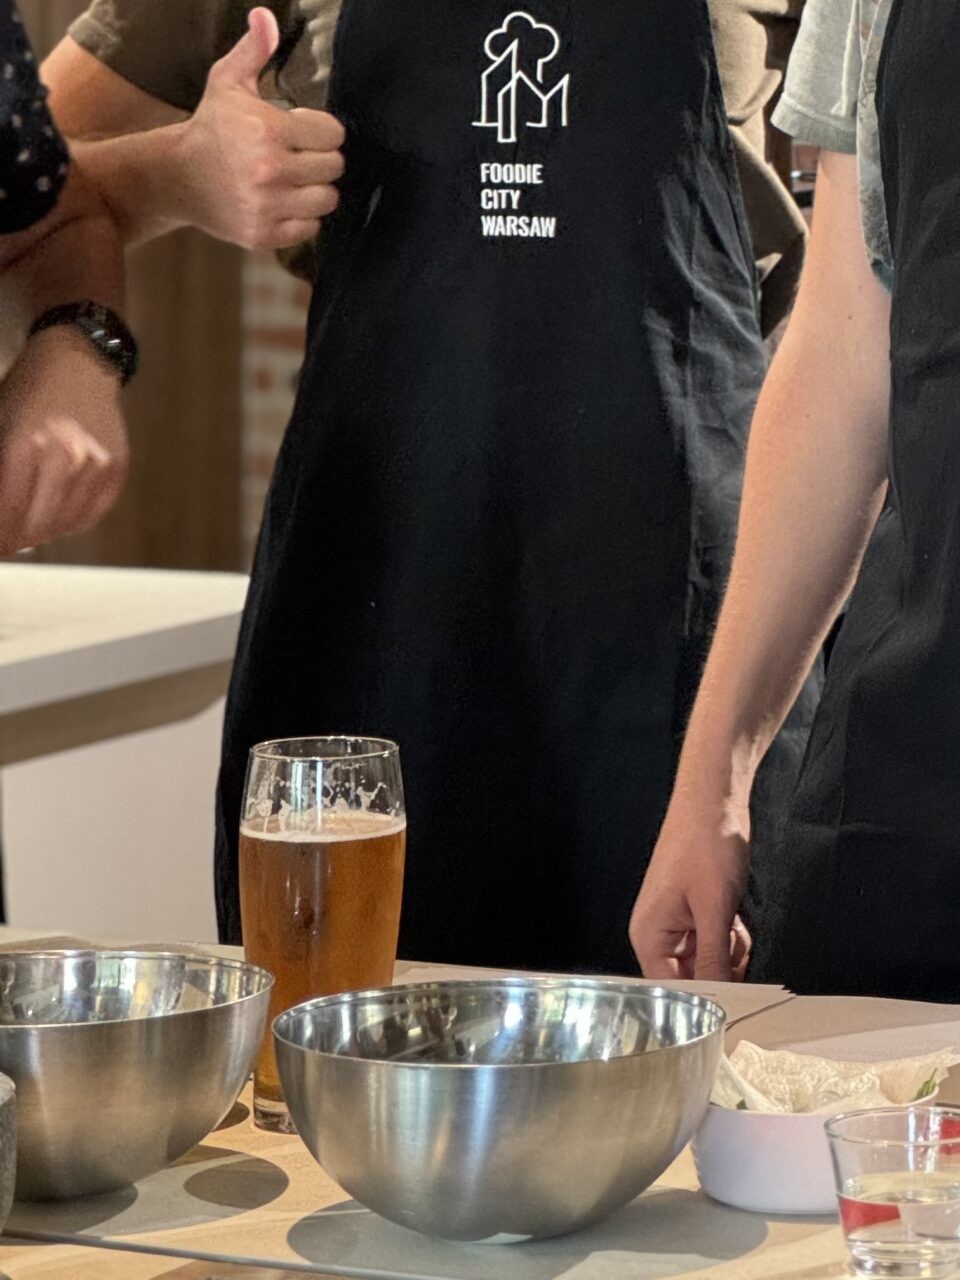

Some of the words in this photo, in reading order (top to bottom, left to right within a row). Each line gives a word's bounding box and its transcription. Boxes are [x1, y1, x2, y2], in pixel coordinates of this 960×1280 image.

[480, 163, 544, 185] FOODIE
[480, 189, 521, 210] CITY
[480, 216, 557, 238] WARSAW
